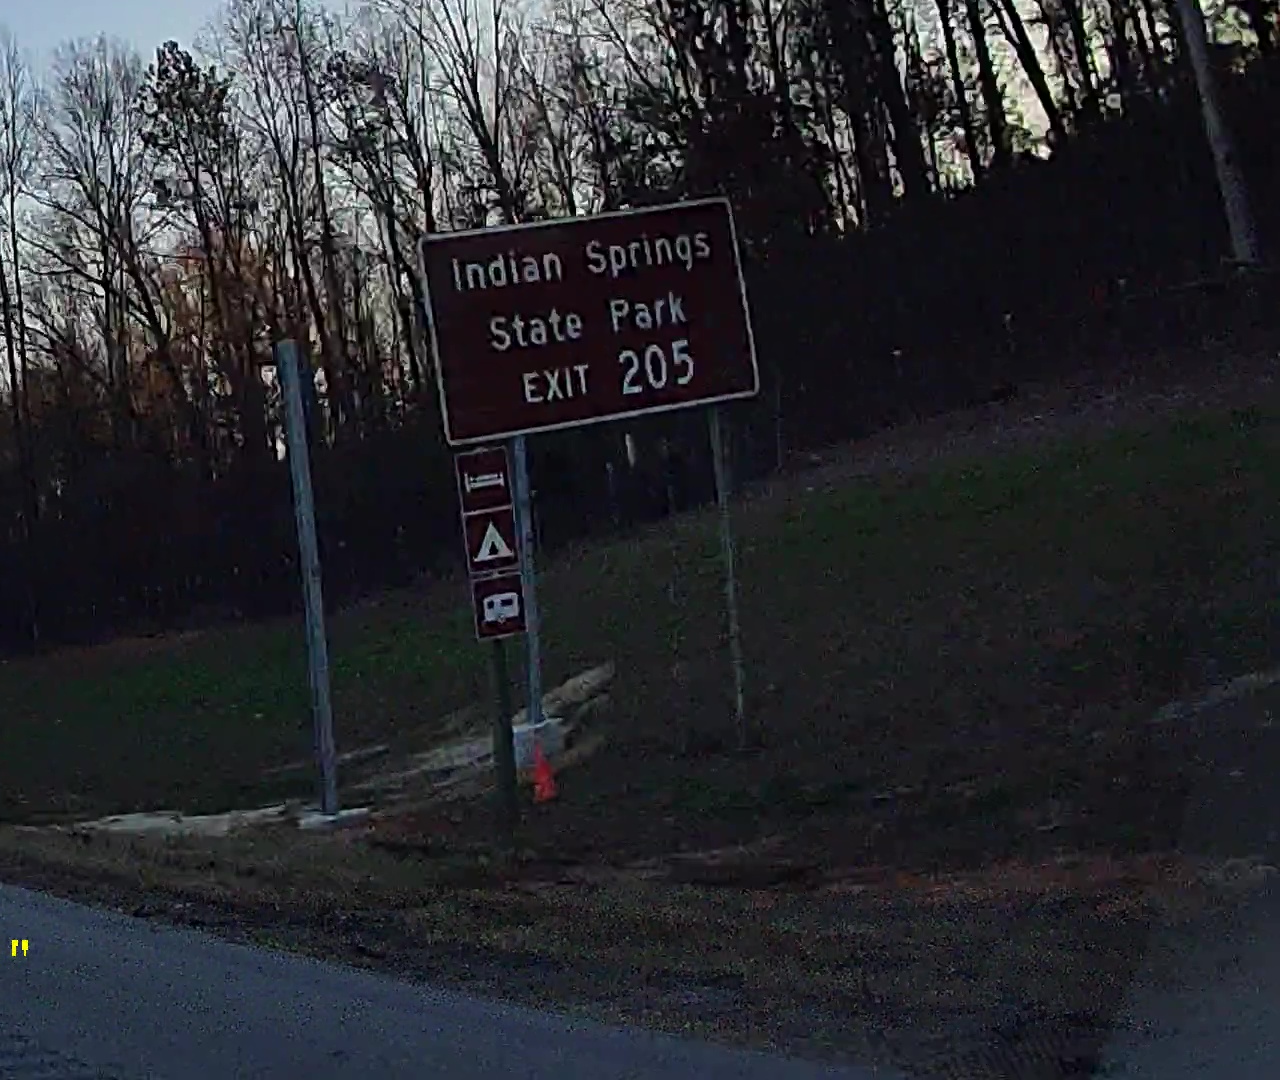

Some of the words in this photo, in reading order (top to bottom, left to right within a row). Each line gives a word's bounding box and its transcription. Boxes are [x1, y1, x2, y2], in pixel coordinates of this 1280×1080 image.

[451, 249, 563, 291] Indian
[586, 232, 711, 278] Springs
[489, 307, 583, 351] State
[609, 291, 688, 333] Park
[522, 364, 590, 404] EXIT
[618, 339, 695, 395] 205
